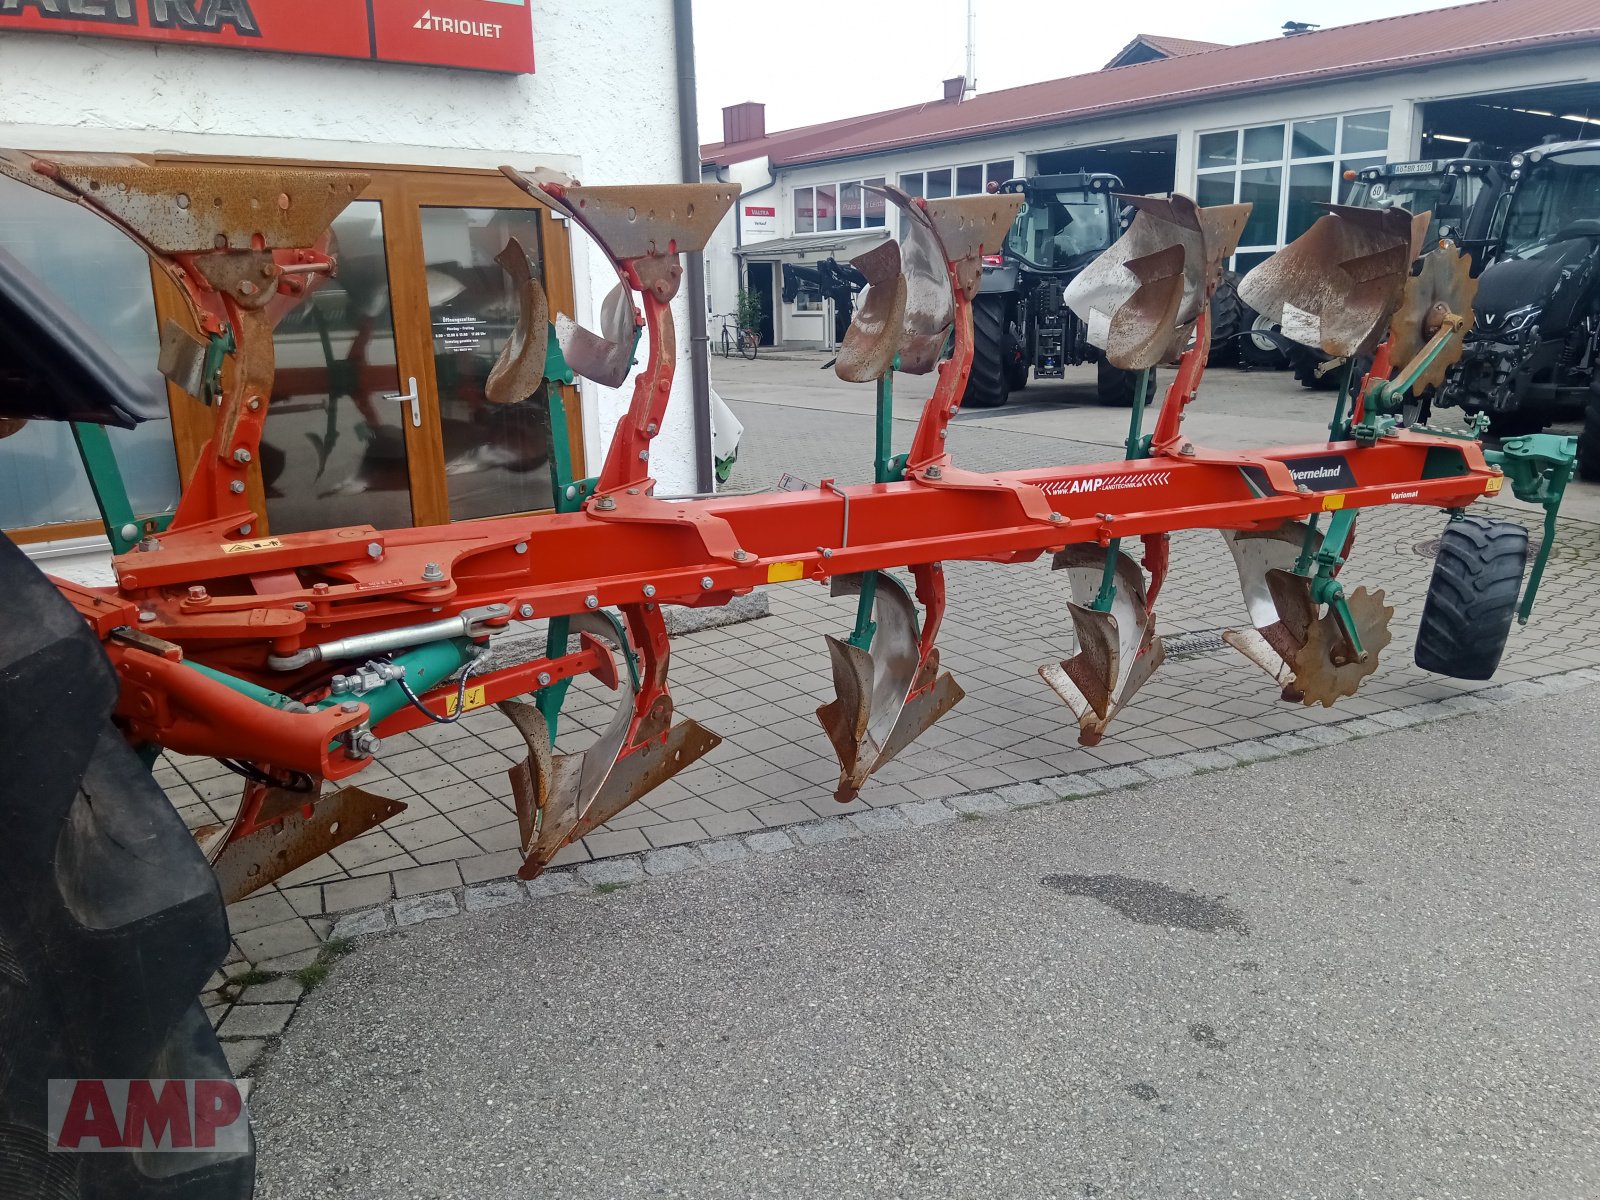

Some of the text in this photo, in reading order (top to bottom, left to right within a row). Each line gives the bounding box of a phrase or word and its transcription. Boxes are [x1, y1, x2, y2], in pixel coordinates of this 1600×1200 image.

[431, 16, 502, 38] TRIOLIET
[1372, 185, 1382, 196] 60
[1391, 490, 1418, 500] Variomat
